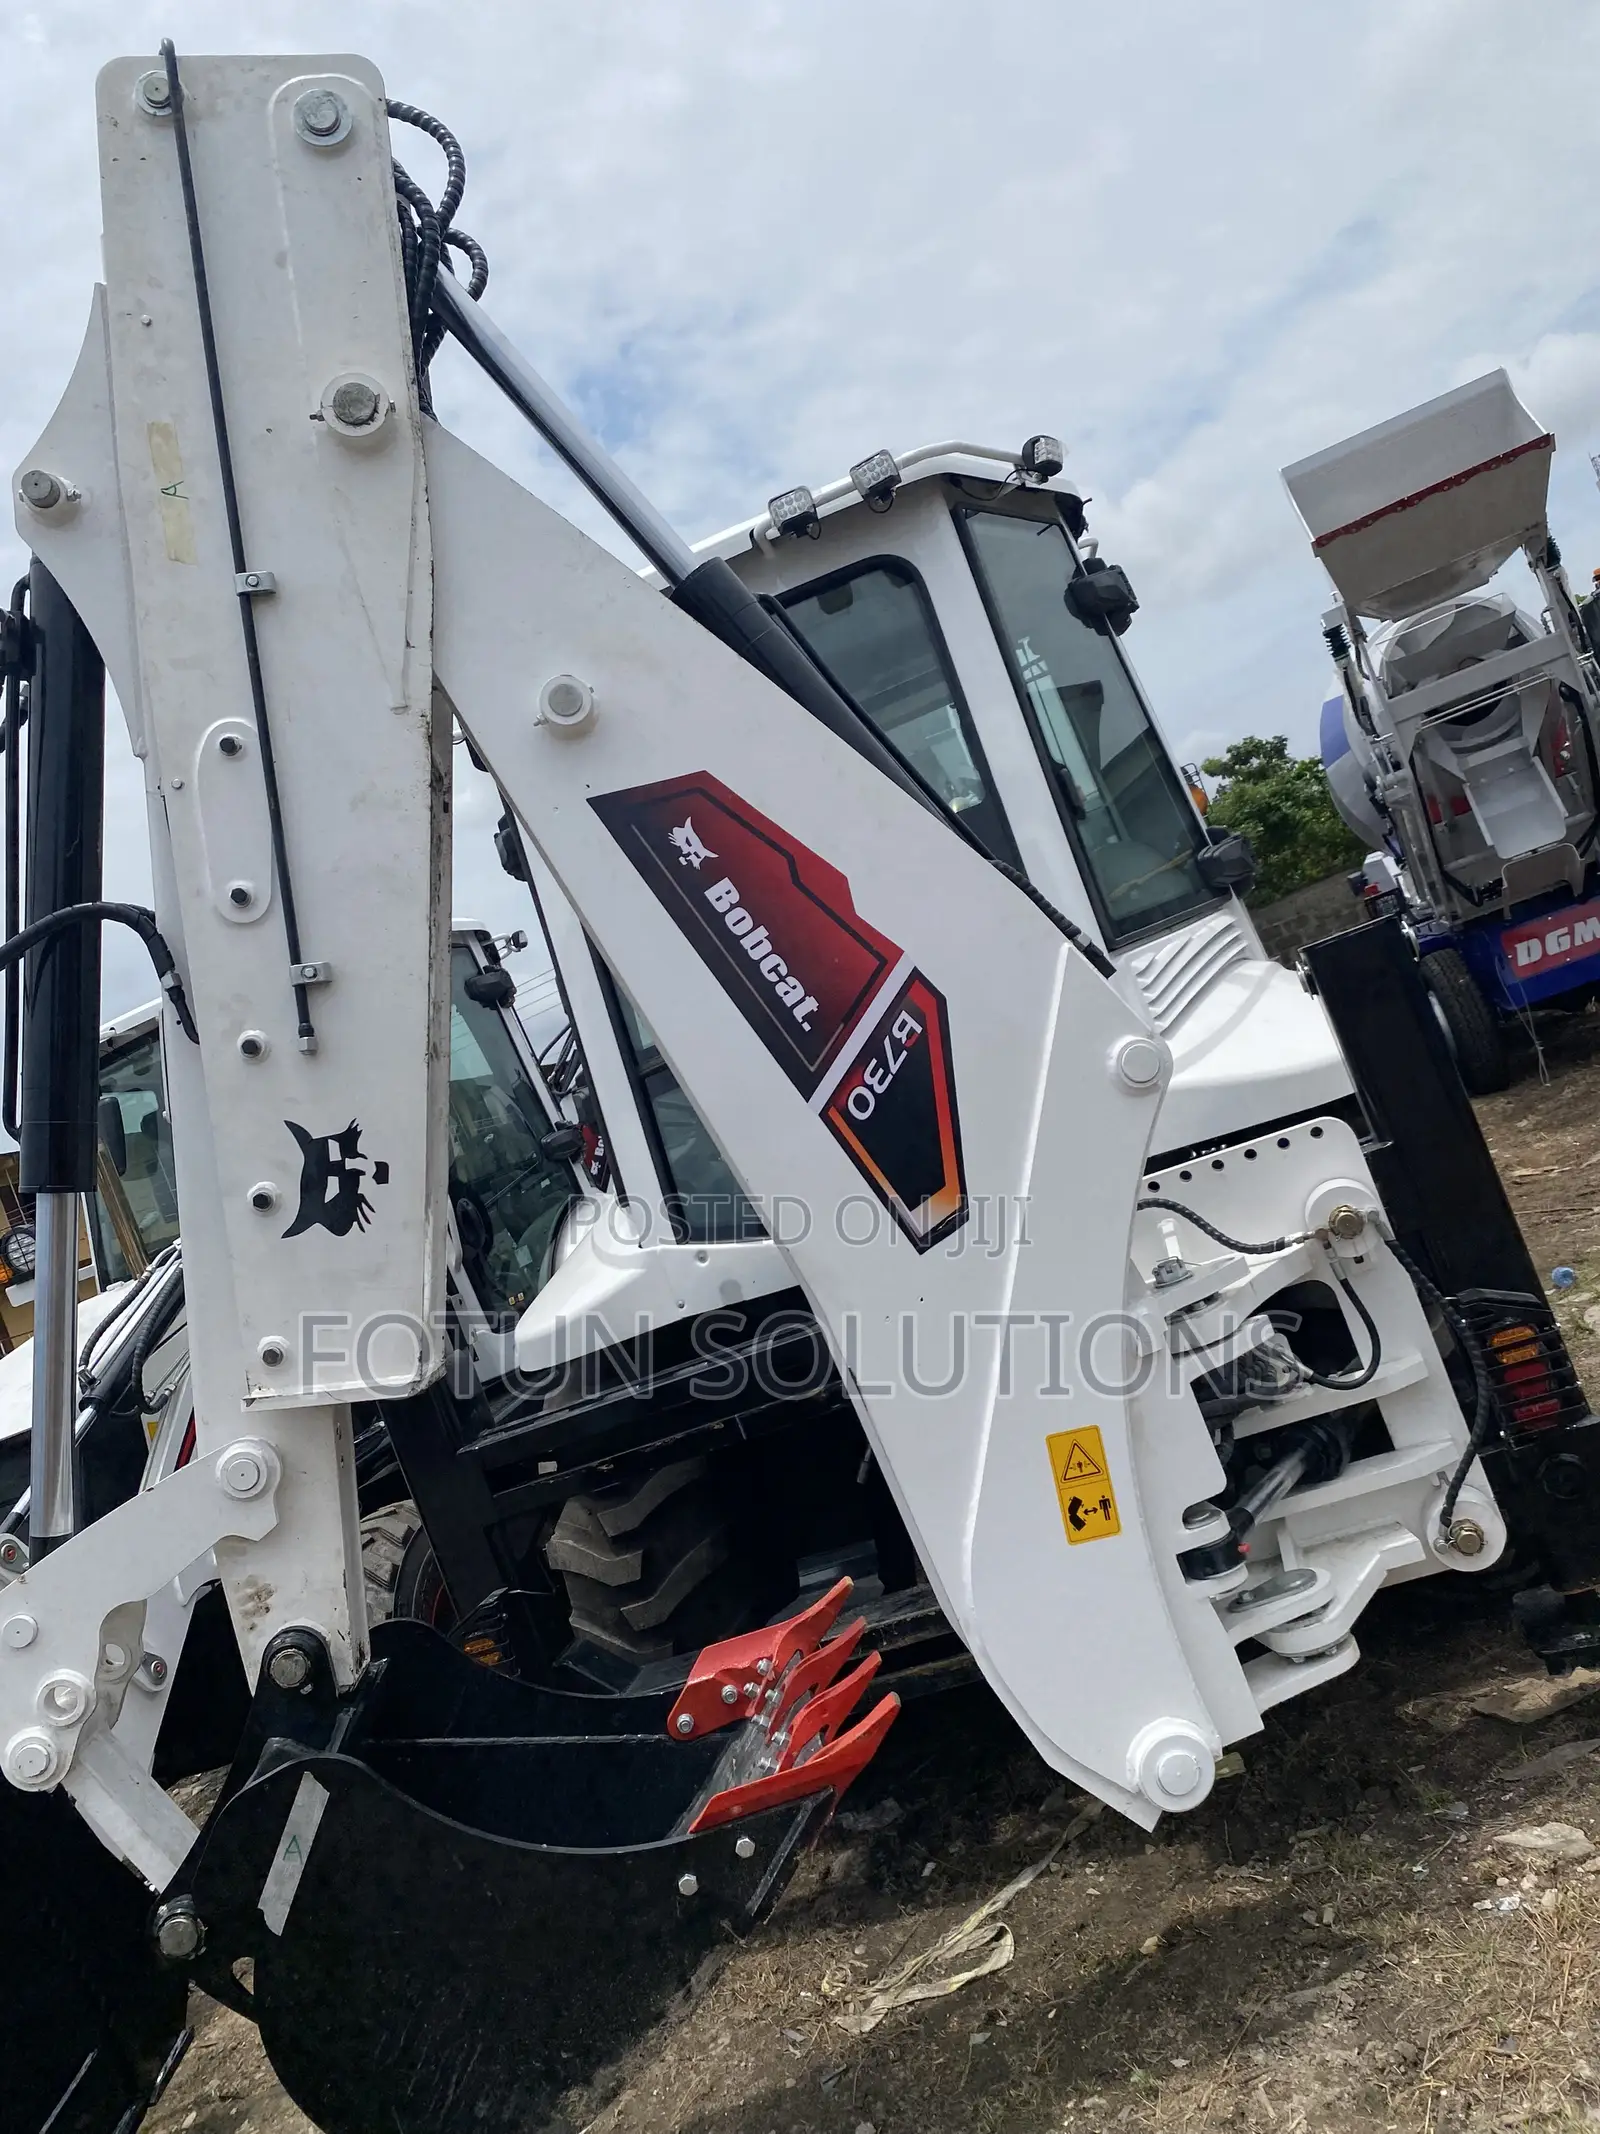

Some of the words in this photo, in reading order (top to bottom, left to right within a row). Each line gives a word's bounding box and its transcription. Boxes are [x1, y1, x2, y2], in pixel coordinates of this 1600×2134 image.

[161, 481, 189, 500] A
[847, 1010, 923, 1121] B730
[282, 1834, 304, 1866] A
